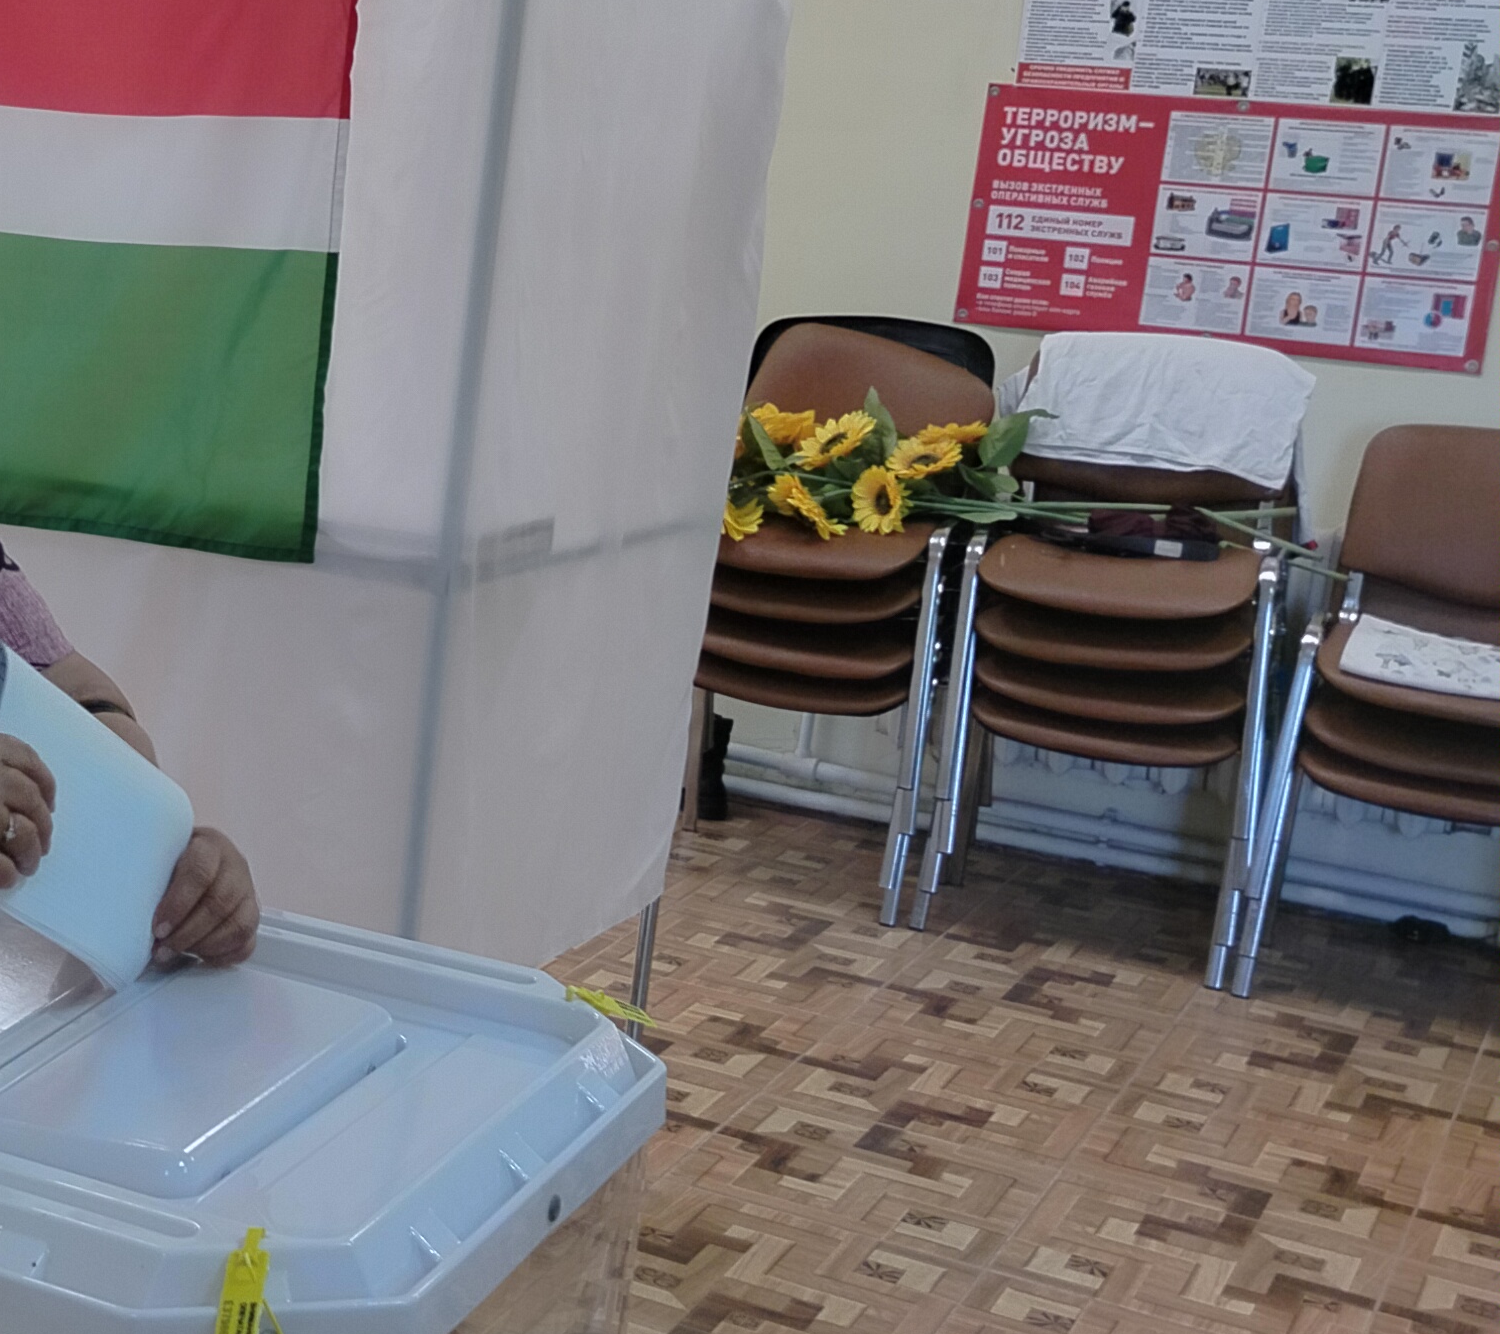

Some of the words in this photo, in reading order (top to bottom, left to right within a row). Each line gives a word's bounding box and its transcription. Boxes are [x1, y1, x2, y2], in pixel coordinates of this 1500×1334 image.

[1000, 127, 1090, 152] УГРОЗА
[996, 148, 1125, 175] ОБЩЕСТВУ
[991, 179, 1030, 192] ВЫЗОВ
[1030, 182, 1103, 198] ЭКСТРЕННЫХ
[990, 190, 1069, 207] ОПЕРАТИВНЫХ
[1069, 196, 1109, 209] СЛУЖБ
[994, 212, 1026, 232] 112
[1030, 215, 1071, 227] ЕДИНЫЙ
[1072, 218, 1104, 229] НОМЕР
[1029, 224, 1089, 238] ЭКСТРЕННЫХ
[1089, 229, 1124, 240] СЛУЖБ
[987, 246, 1003, 256] 101
[1068, 253, 1086, 263] 102
[982, 272, 999, 282] 103
[1064, 280, 1082, 290] 104
